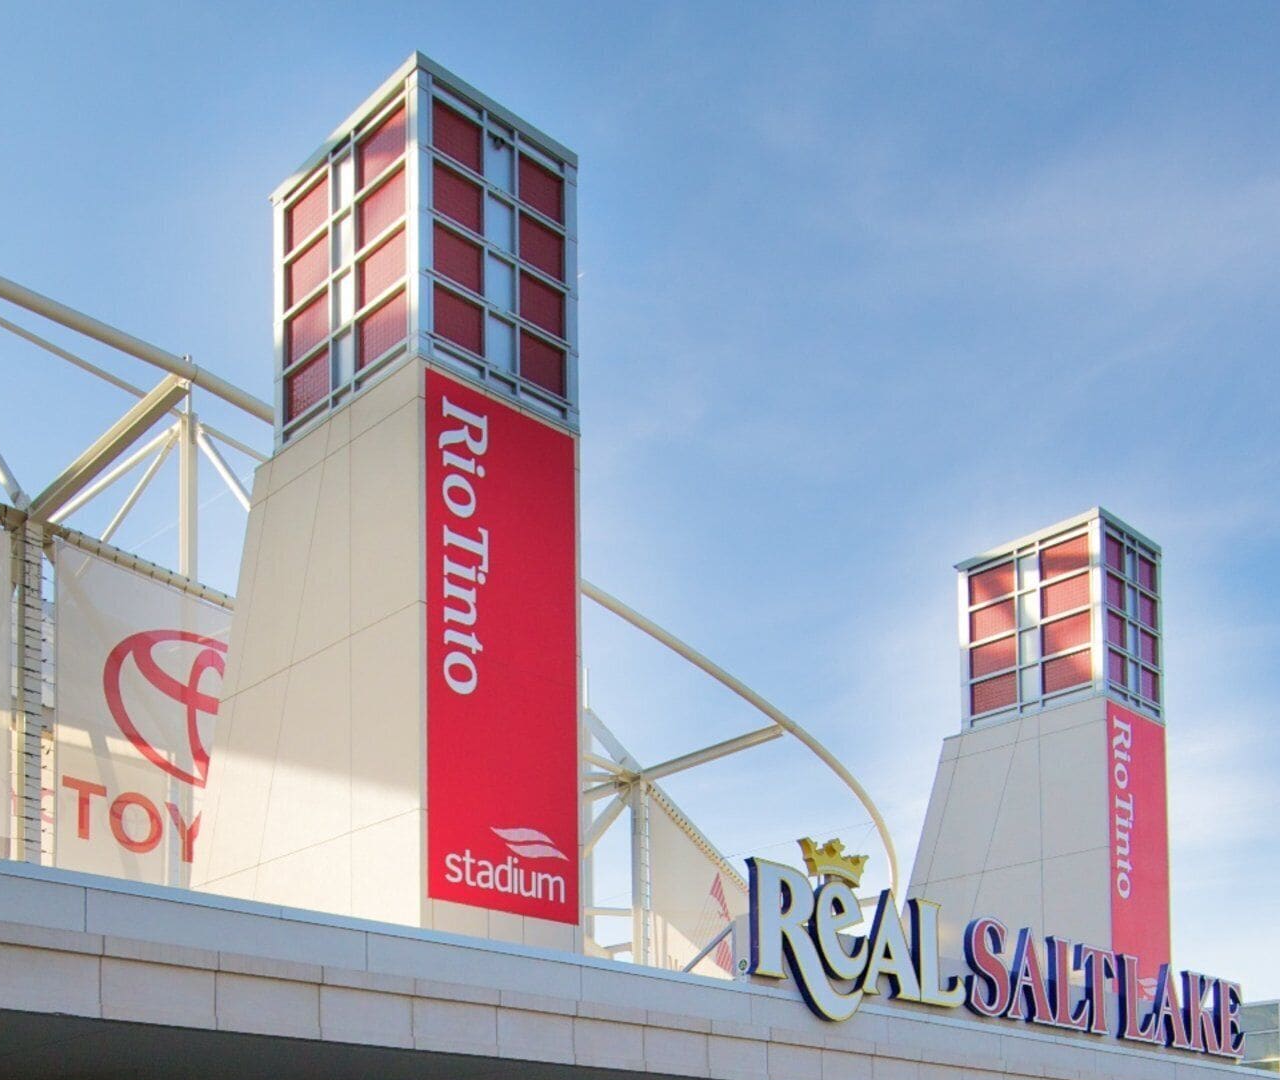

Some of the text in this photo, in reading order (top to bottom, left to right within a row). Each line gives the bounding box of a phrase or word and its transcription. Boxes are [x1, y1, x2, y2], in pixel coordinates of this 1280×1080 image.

[437, 395, 490, 697] Rio Tinto
[444, 849, 566, 904] stadium
[1111, 715, 1134, 900] Rio Tinto
[964, 916, 1115, 1034] SALT
[1115, 953, 1246, 1060] LAKE
